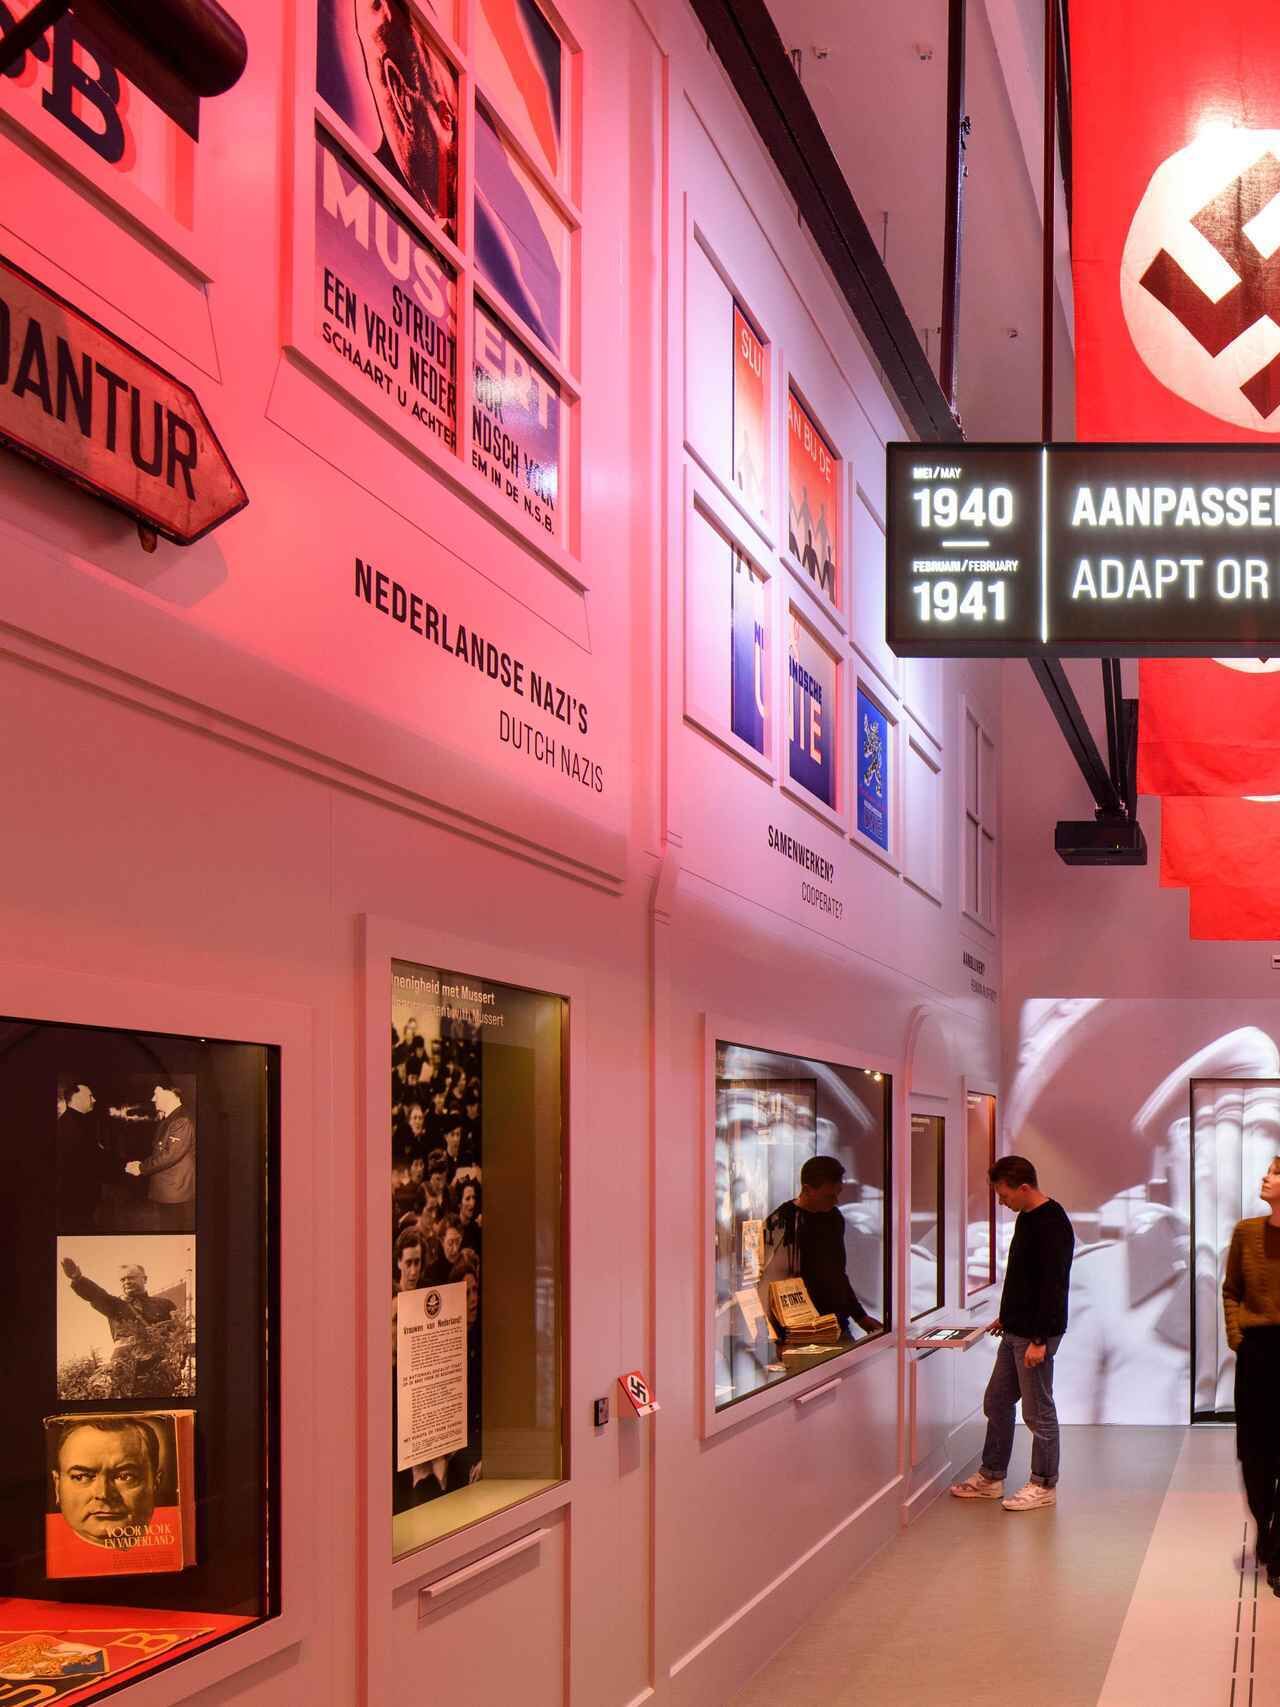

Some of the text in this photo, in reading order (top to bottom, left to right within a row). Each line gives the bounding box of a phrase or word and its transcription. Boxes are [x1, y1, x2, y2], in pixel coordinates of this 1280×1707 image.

[324, 267, 357, 335] EEN
[322, 322, 555, 535] SCHAART U ACHTER EM IN DE N.S.B.
[819, 447, 832, 483] DE
[912, 486, 1014, 528] 1940
[1072, 559, 1203, 600] ADAPT
[1217, 559, 1269, 600] OR
[912, 580, 1006, 624] 1941
[354, 557, 588, 735] NEDERLANDSE NAZI'S
[500, 710, 603, 793] DUTCH NAZIS
[768, 824, 834, 884] SAMENWERKEN?
[801, 881, 843, 920] COOPERATE?
[392, 973, 496, 1006] nenigheid met Mussert
[472, 1008, 504, 1028] Mussert
[105, 1534, 175, 1549] EN VADERLAND
[107, 1523, 171, 1538] VOOR VOLK
